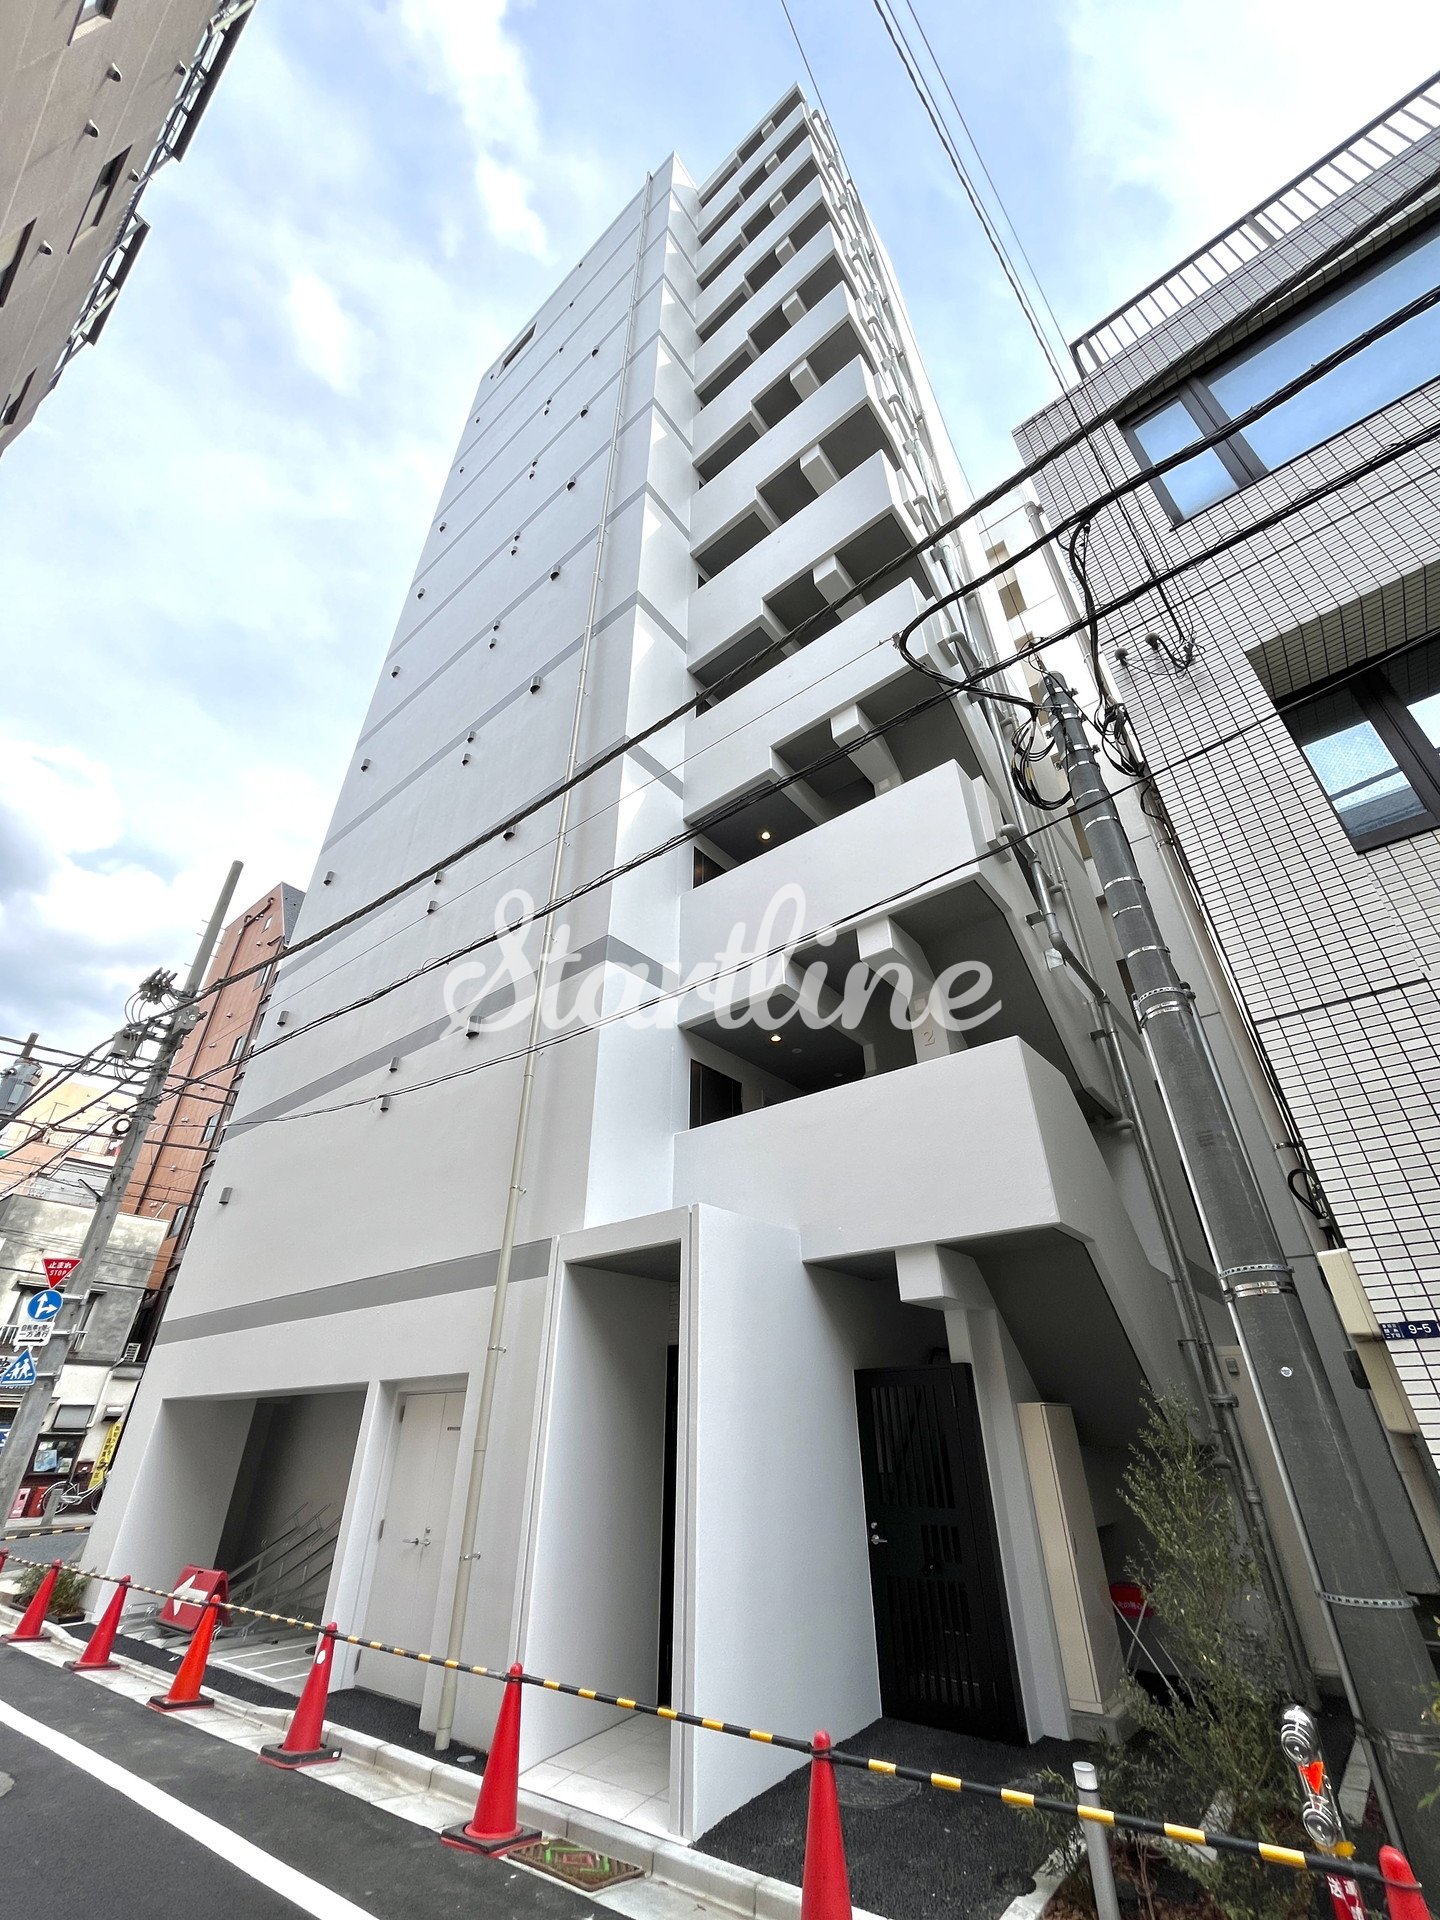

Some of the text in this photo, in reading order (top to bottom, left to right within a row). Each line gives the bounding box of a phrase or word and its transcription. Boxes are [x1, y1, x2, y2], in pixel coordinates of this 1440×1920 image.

[923, 1030, 935, 1047] 2
[48, 1261, 72, 1269] 止まれ
[1408, 1323, 1432, 1334] 9-5
